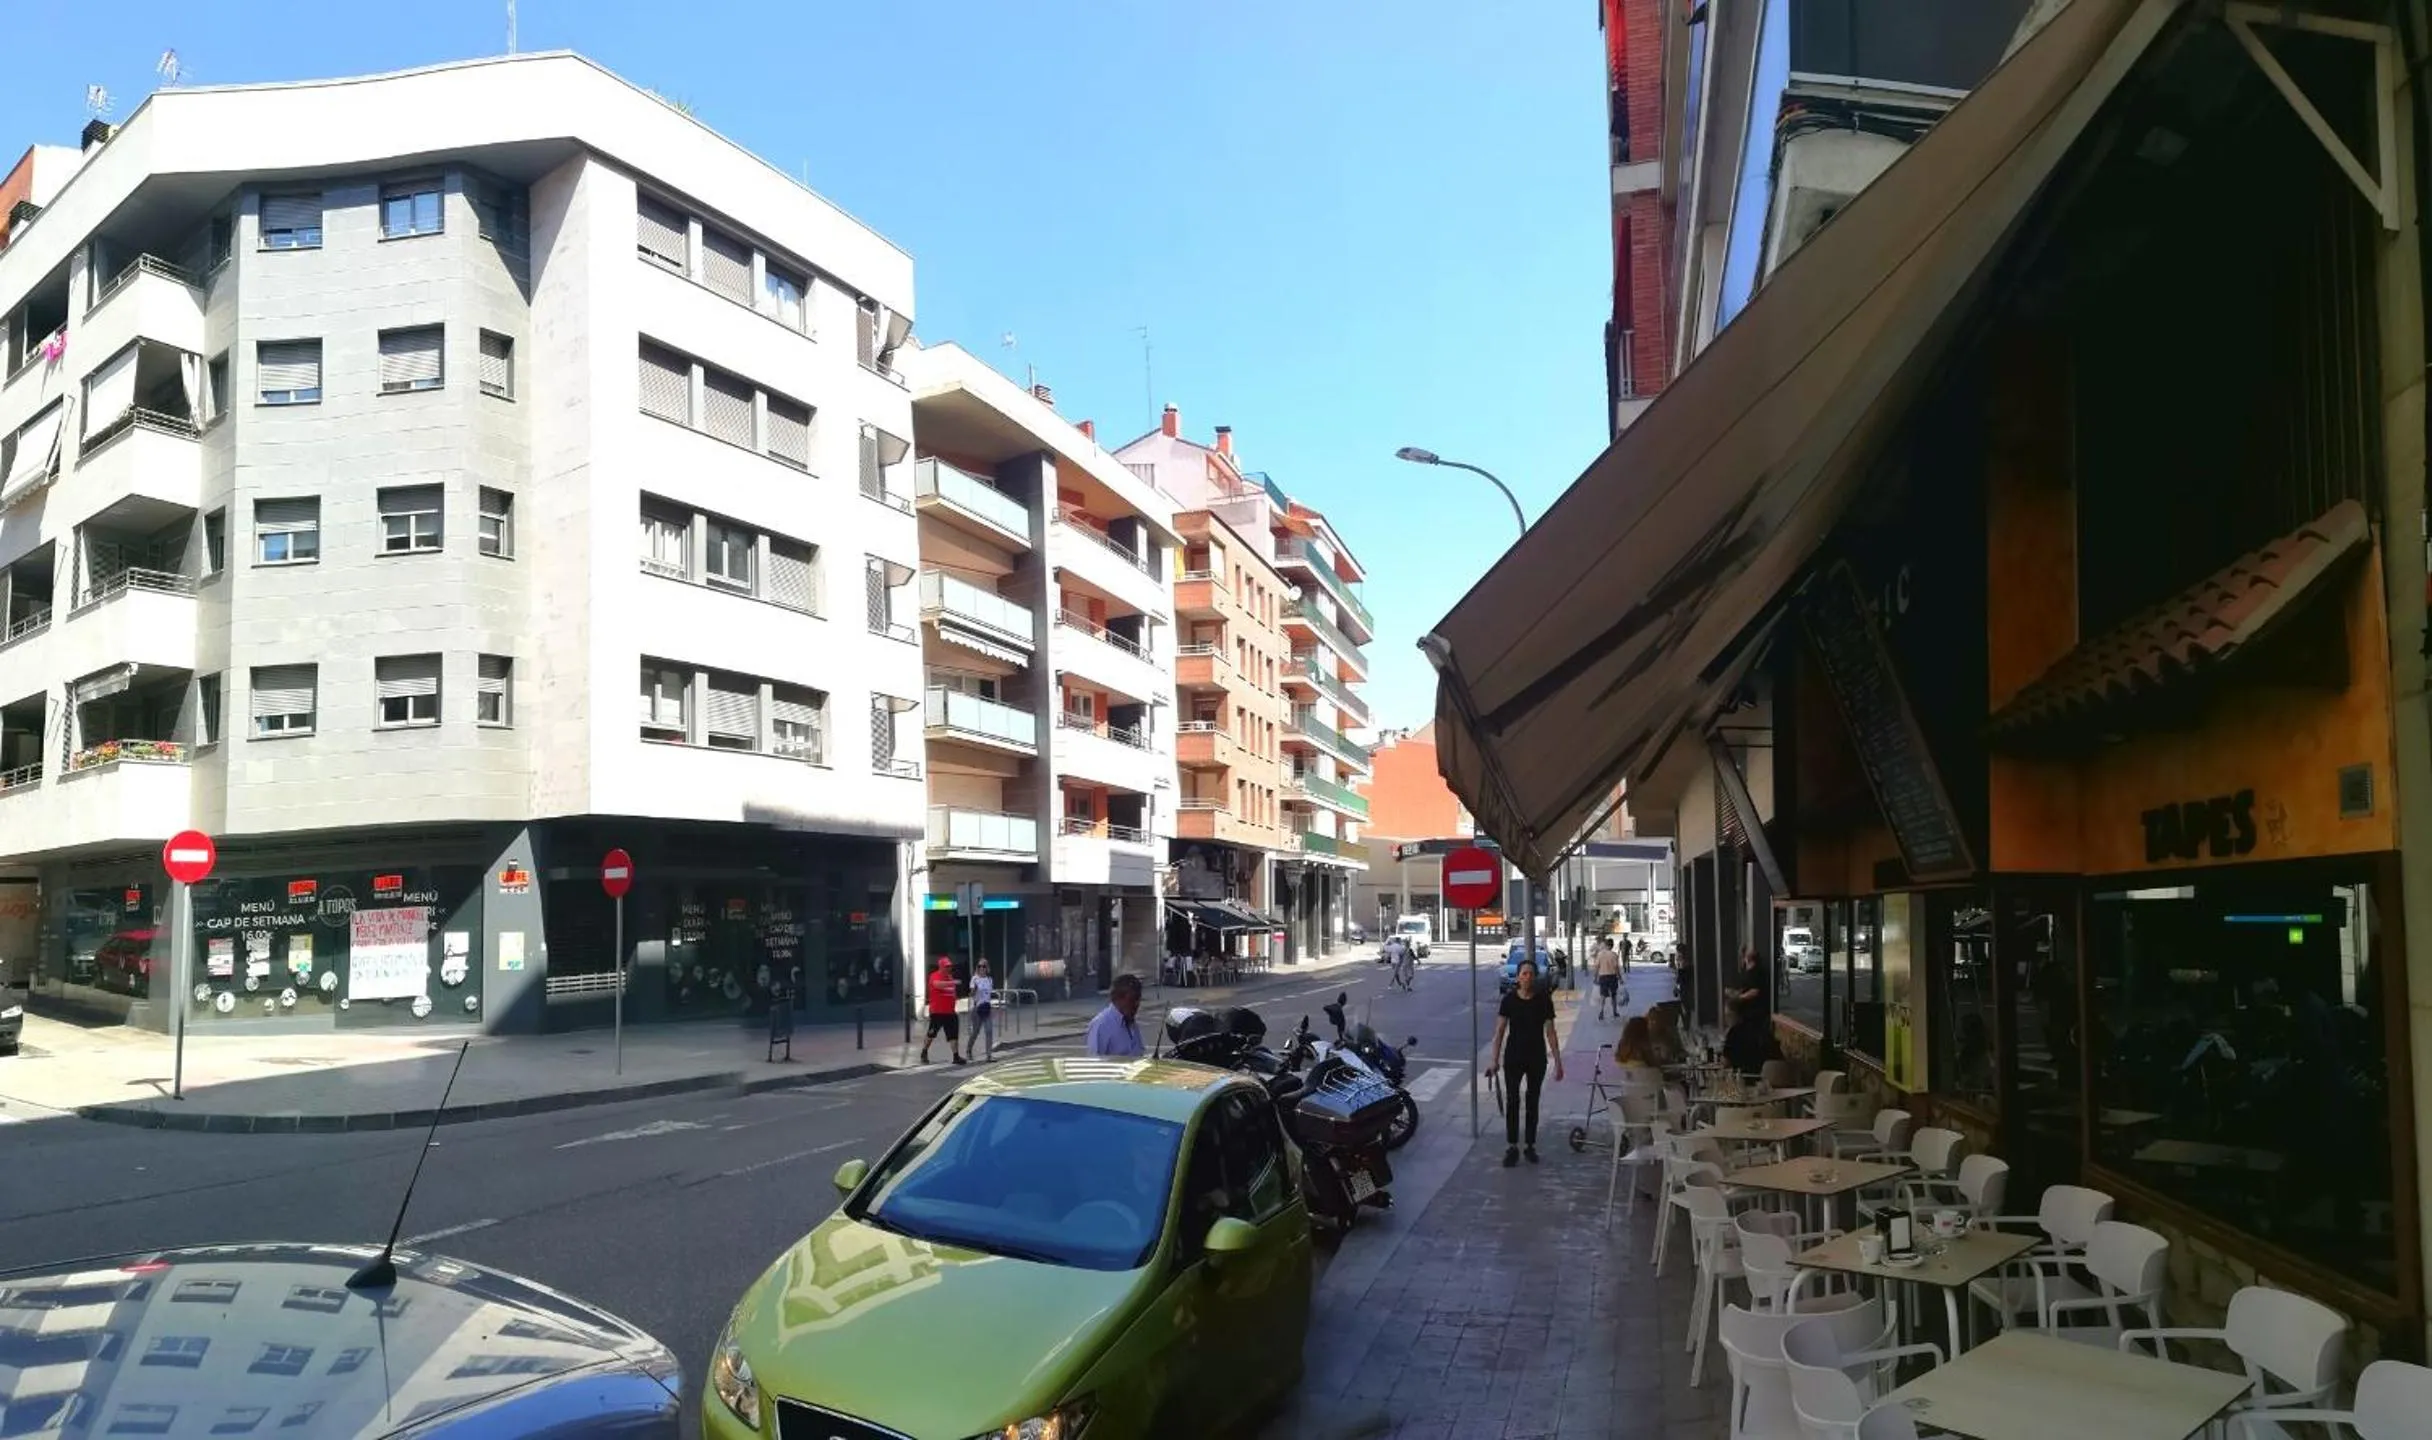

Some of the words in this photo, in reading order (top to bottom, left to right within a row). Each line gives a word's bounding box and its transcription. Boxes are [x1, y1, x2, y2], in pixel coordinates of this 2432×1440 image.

[2141, 788, 2257, 864] TAPES
[403, 889, 439, 903] MENÚ
[241, 899, 275, 913] MENÚ
[234, 916, 250, 928] DE
[252, 913, 306, 927] SETMANA
